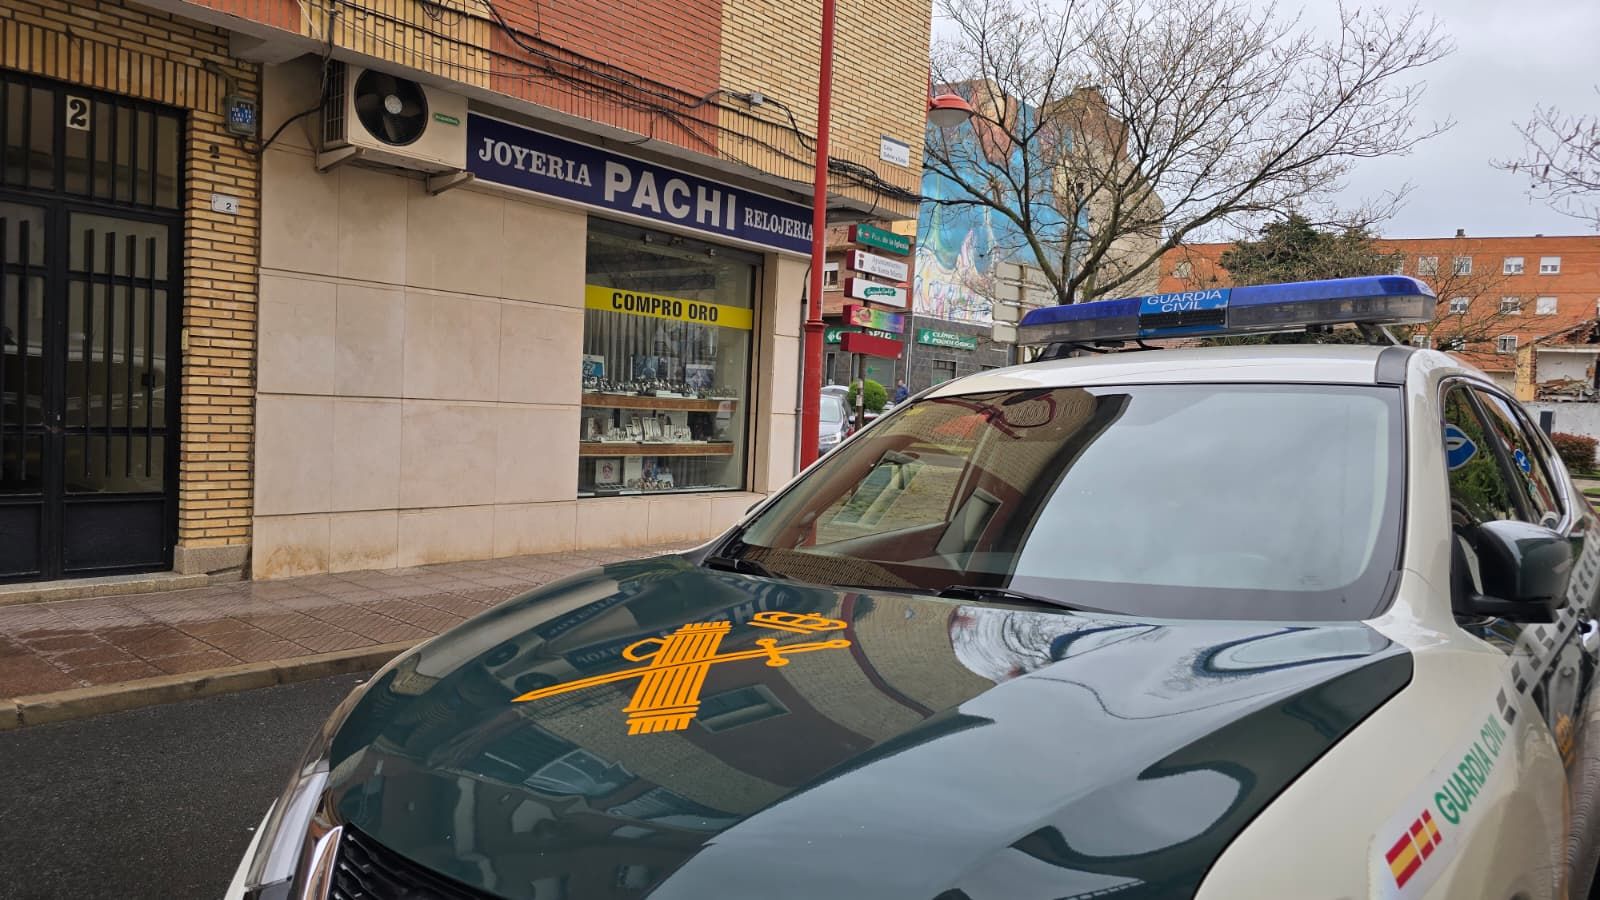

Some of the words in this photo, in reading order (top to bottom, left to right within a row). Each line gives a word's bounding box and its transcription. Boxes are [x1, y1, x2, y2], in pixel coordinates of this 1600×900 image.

[70, 98, 88, 127] 2
[209, 144, 220, 159] 2
[479, 137, 592, 187] JOYERIA
[605, 160, 736, 231] PACHI
[744, 207, 814, 241] RELOJERIA
[612, 292, 682, 317] COMPRO
[688, 303, 718, 322] ORO
[1147, 290, 1222, 305] GUARDIA
[1161, 301, 1202, 313] CIVIL
[1434, 742, 1495, 825] GUARDIA
[1480, 713, 1507, 757] CIVIL
